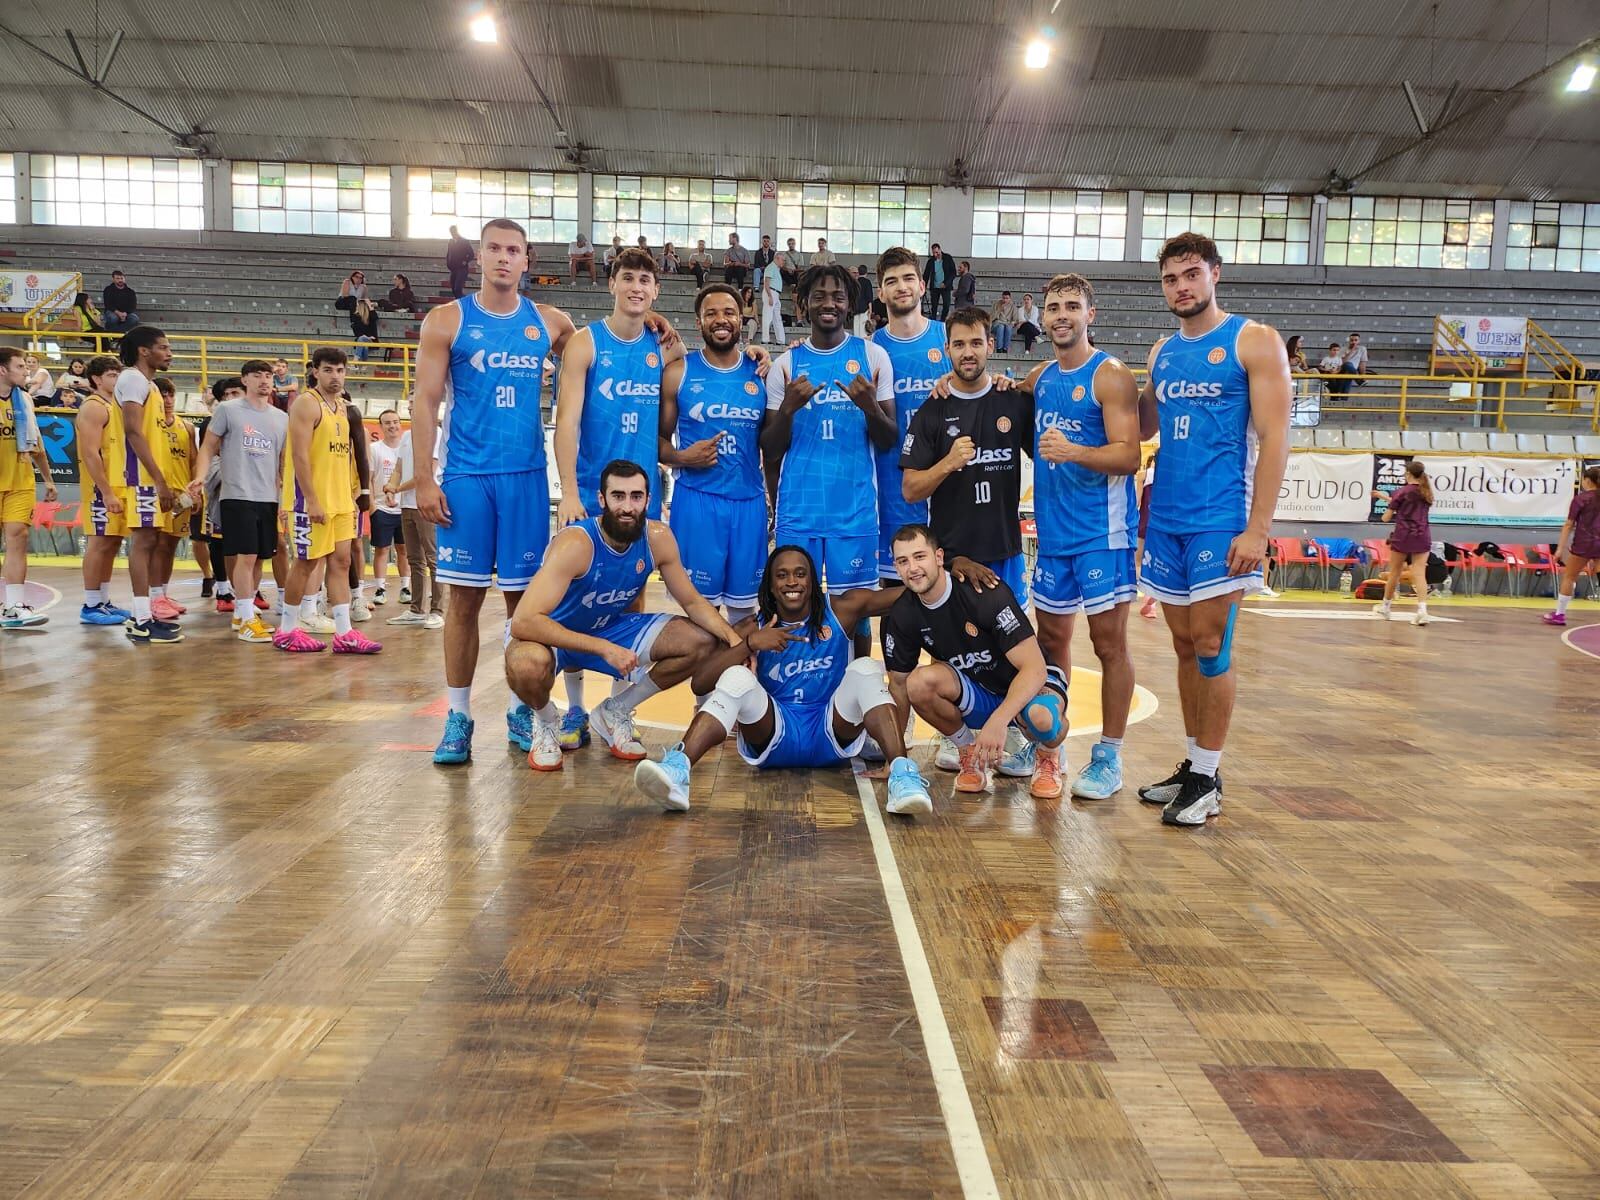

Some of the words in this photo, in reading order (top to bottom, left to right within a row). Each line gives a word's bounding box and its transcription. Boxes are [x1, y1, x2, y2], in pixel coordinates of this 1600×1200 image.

[1477, 332, 1522, 346] UEM
[487, 351, 540, 369] Class
[495, 386, 516, 408] 20
[615, 380, 661, 396] Class
[1167, 380, 1223, 398] Class
[706, 404, 761, 421] Class
[1043, 411, 1082, 432] Class
[621, 412, 638, 434] 99
[822, 419, 834, 440] 11
[1173, 415, 1191, 440] 19
[329, 441, 350, 454] HOMS
[1377, 459, 1406, 476] 25
[1377, 476, 1407, 485] ANYS
[1429, 465, 1558, 495] olldeforn
[974, 481, 991, 504] 10
[1278, 479, 1364, 501] STUDIO
[1277, 502, 1324, 512] tudio.com
[1435, 497, 1475, 510] màcia
[784, 655, 834, 678] Class
[793, 688, 804, 704] 2
